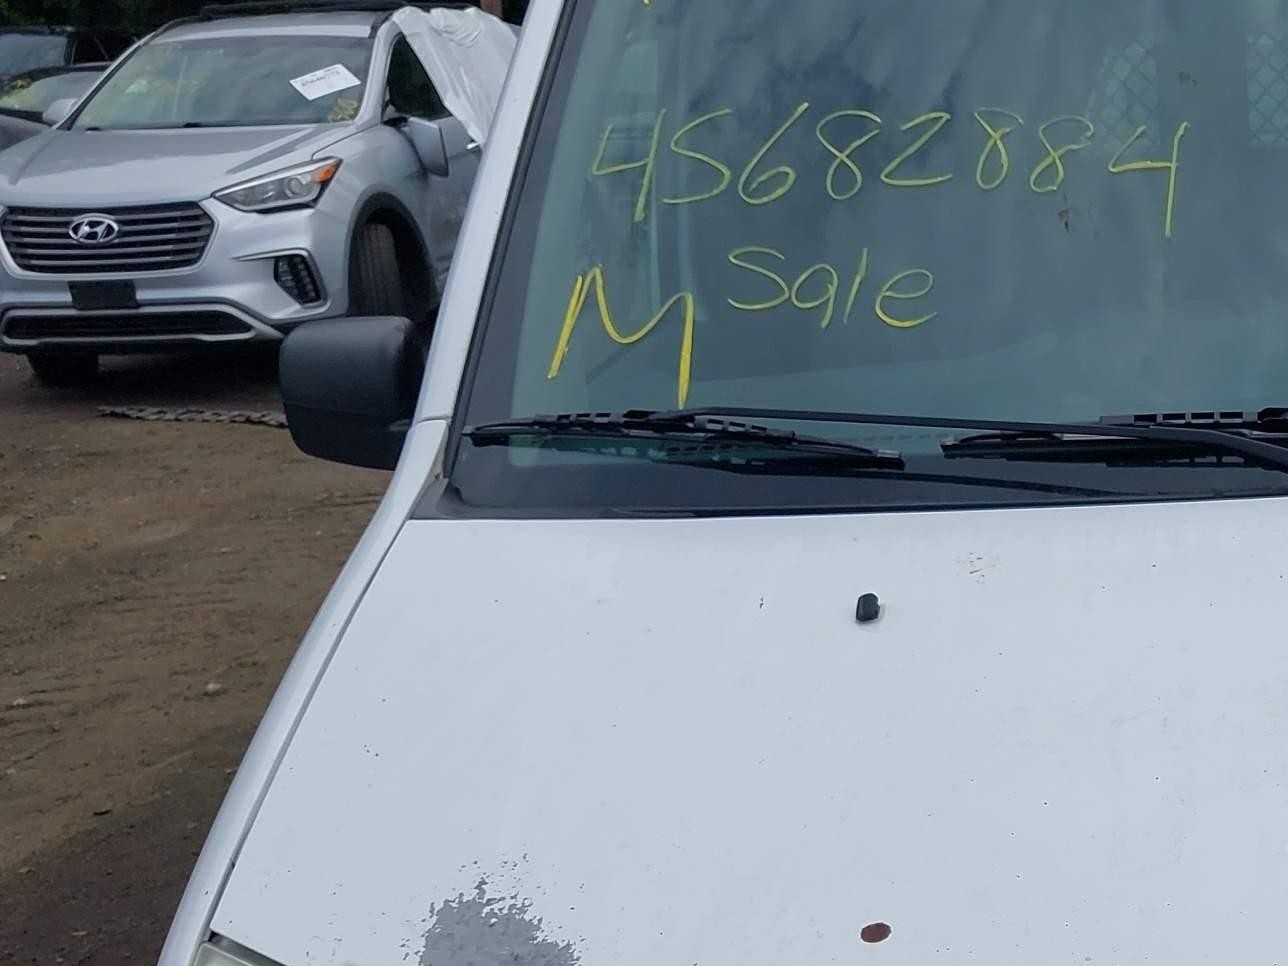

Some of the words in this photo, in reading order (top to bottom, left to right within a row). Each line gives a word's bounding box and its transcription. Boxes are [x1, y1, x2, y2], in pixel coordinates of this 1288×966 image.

[592, 102, 1190, 238] 45682884
[547, 265, 695, 409] M
[727, 247, 938, 329] Sale
